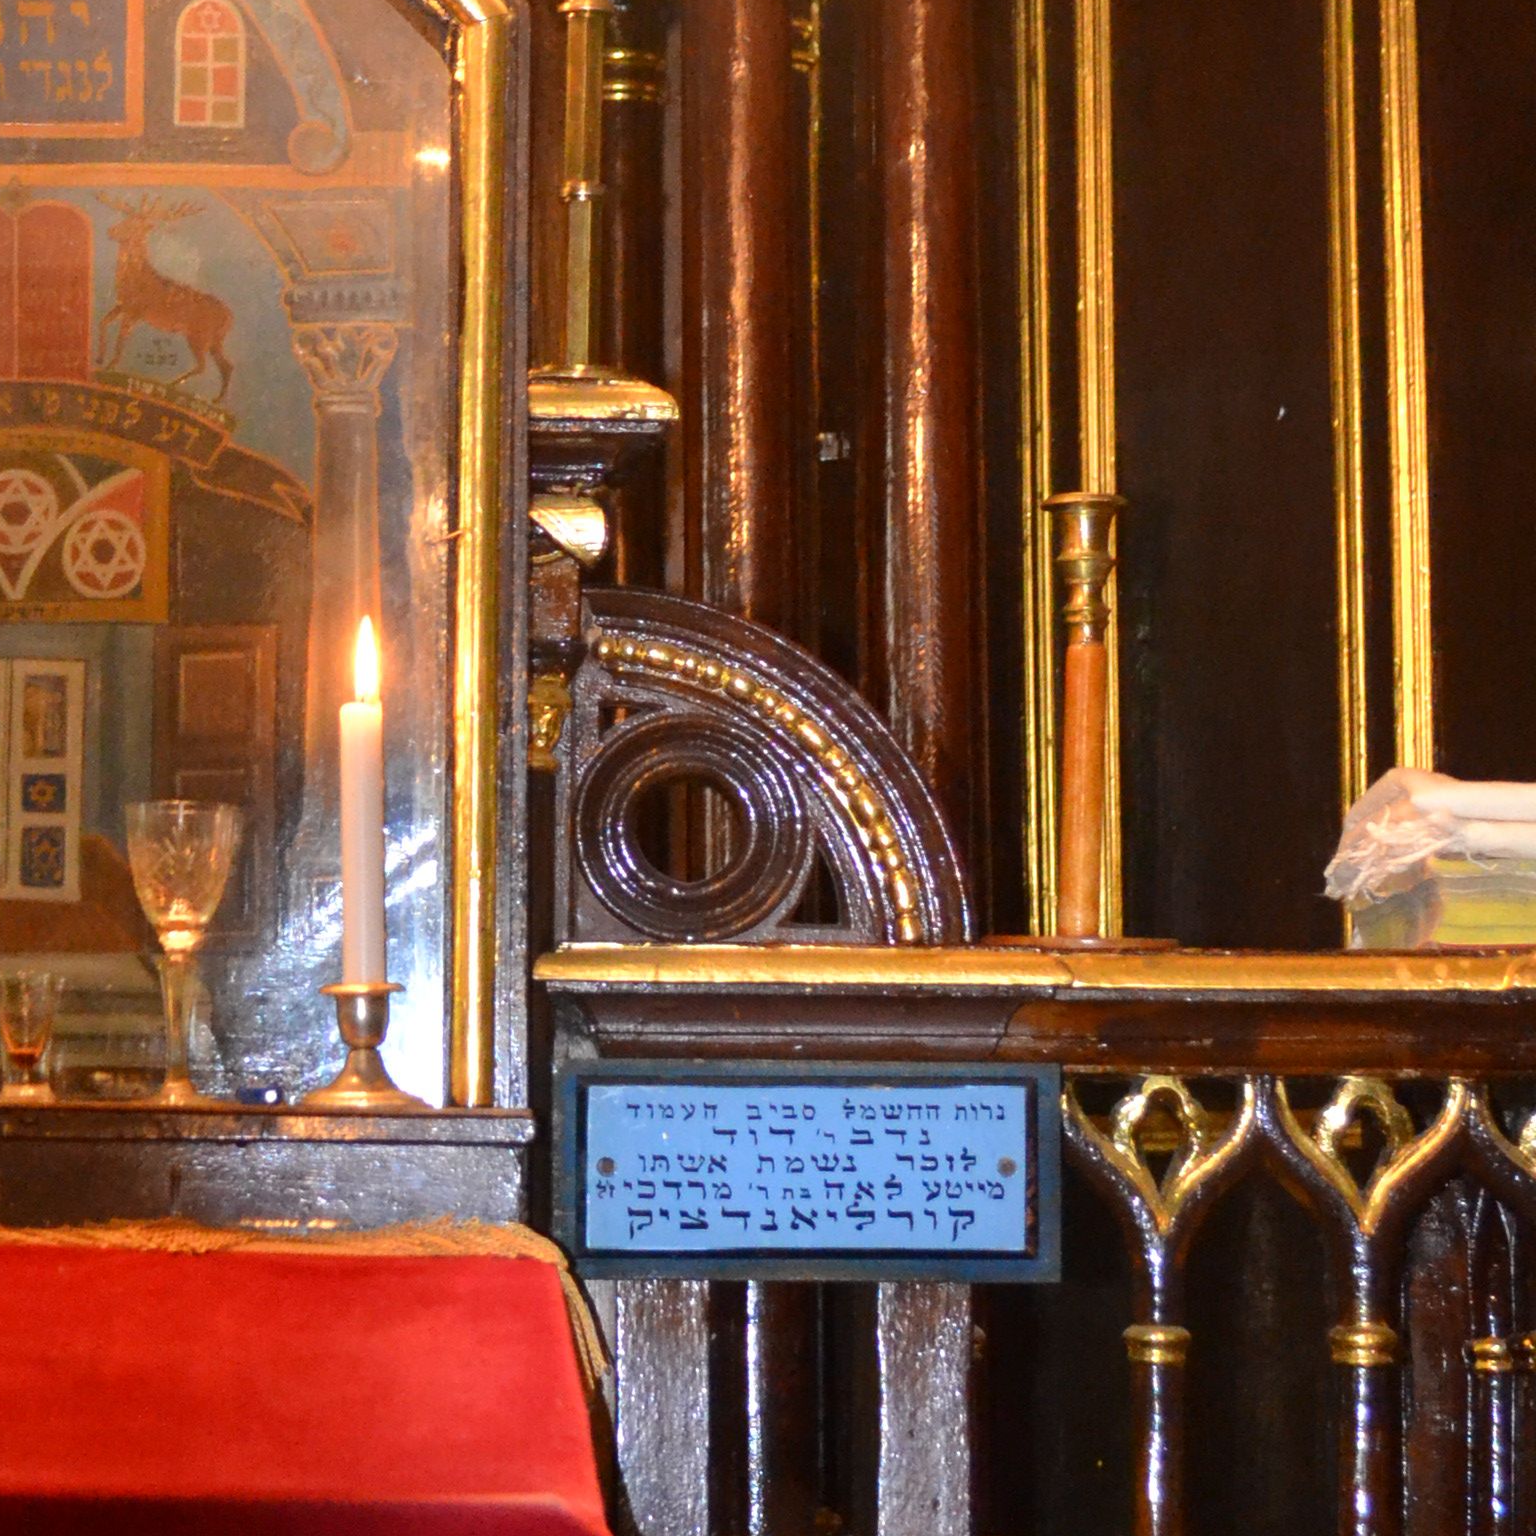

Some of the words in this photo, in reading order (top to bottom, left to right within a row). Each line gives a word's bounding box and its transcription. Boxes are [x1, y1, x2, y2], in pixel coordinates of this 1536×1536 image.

[19, 48, 114, 104] לנגדי
[75, 392, 143, 431] לפני
[152, 415, 200, 451] דע
[626, 1102, 718, 1121] העמוד
[746, 1104, 816, 1121] סביב
[842, 1098, 940, 1120] החשמל
[954, 1103, 1005, 1120] נרות
[713, 1126, 795, 1146] דוד
[850, 1127, 931, 1145] נדב
[638, 1154, 728, 1173] אשתו
[756, 1154, 857, 1173] נשמת
[895, 1147, 977, 1172] לזכר
[623, 1179, 733, 1200] מרדכי
[782, 1186, 812, 1200] בת
[824, 1174, 902, 1201] לאה
[922, 1179, 1005, 1201] מייטע
[627, 1201, 975, 1242] קורליאנדציק
